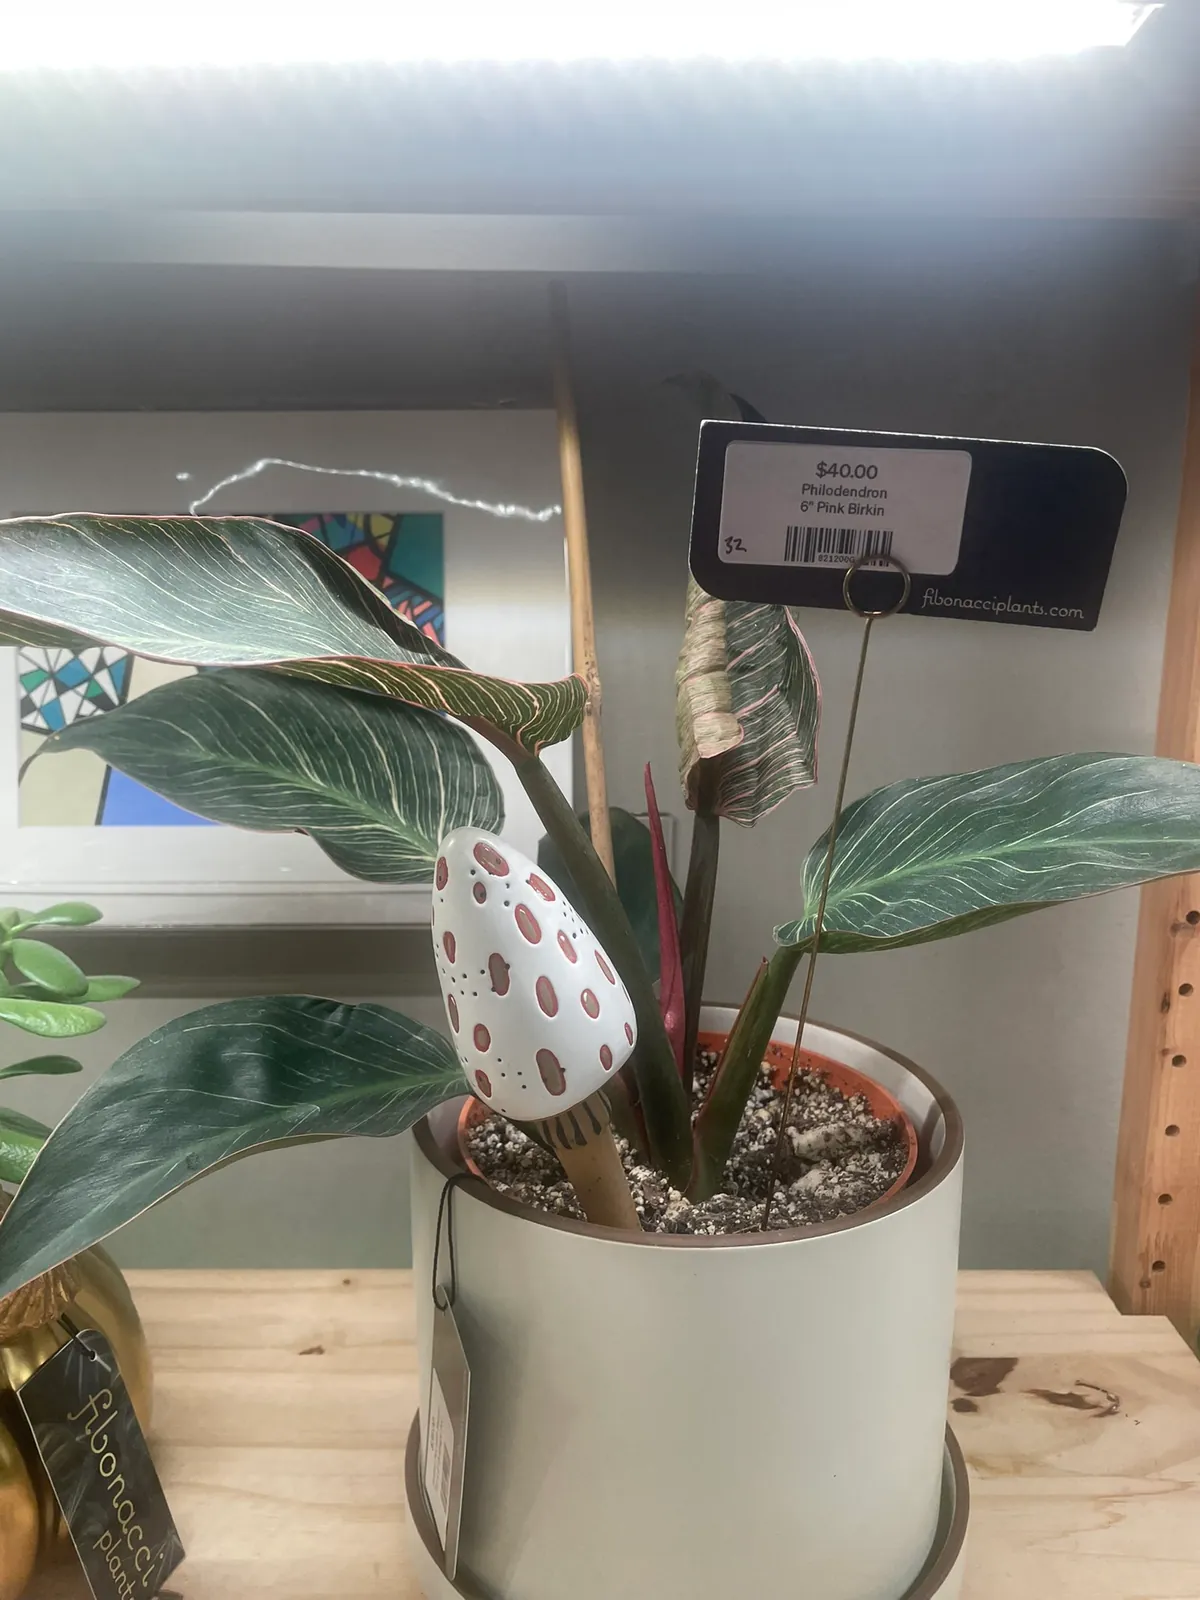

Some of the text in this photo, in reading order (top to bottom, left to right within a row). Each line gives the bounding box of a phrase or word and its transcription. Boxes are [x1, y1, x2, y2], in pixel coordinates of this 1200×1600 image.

[815, 460, 878, 480] $40.00
[801, 483, 888, 499] Philodendron
[800, 500, 885, 516] 6" Pink Birkin
[723, 535, 748, 555] 32
[921, 587, 1085, 619] fibonacciplants.com
[66, 1388, 165, 1588] fibonacci
[92, 1529, 136, 1600] plant
